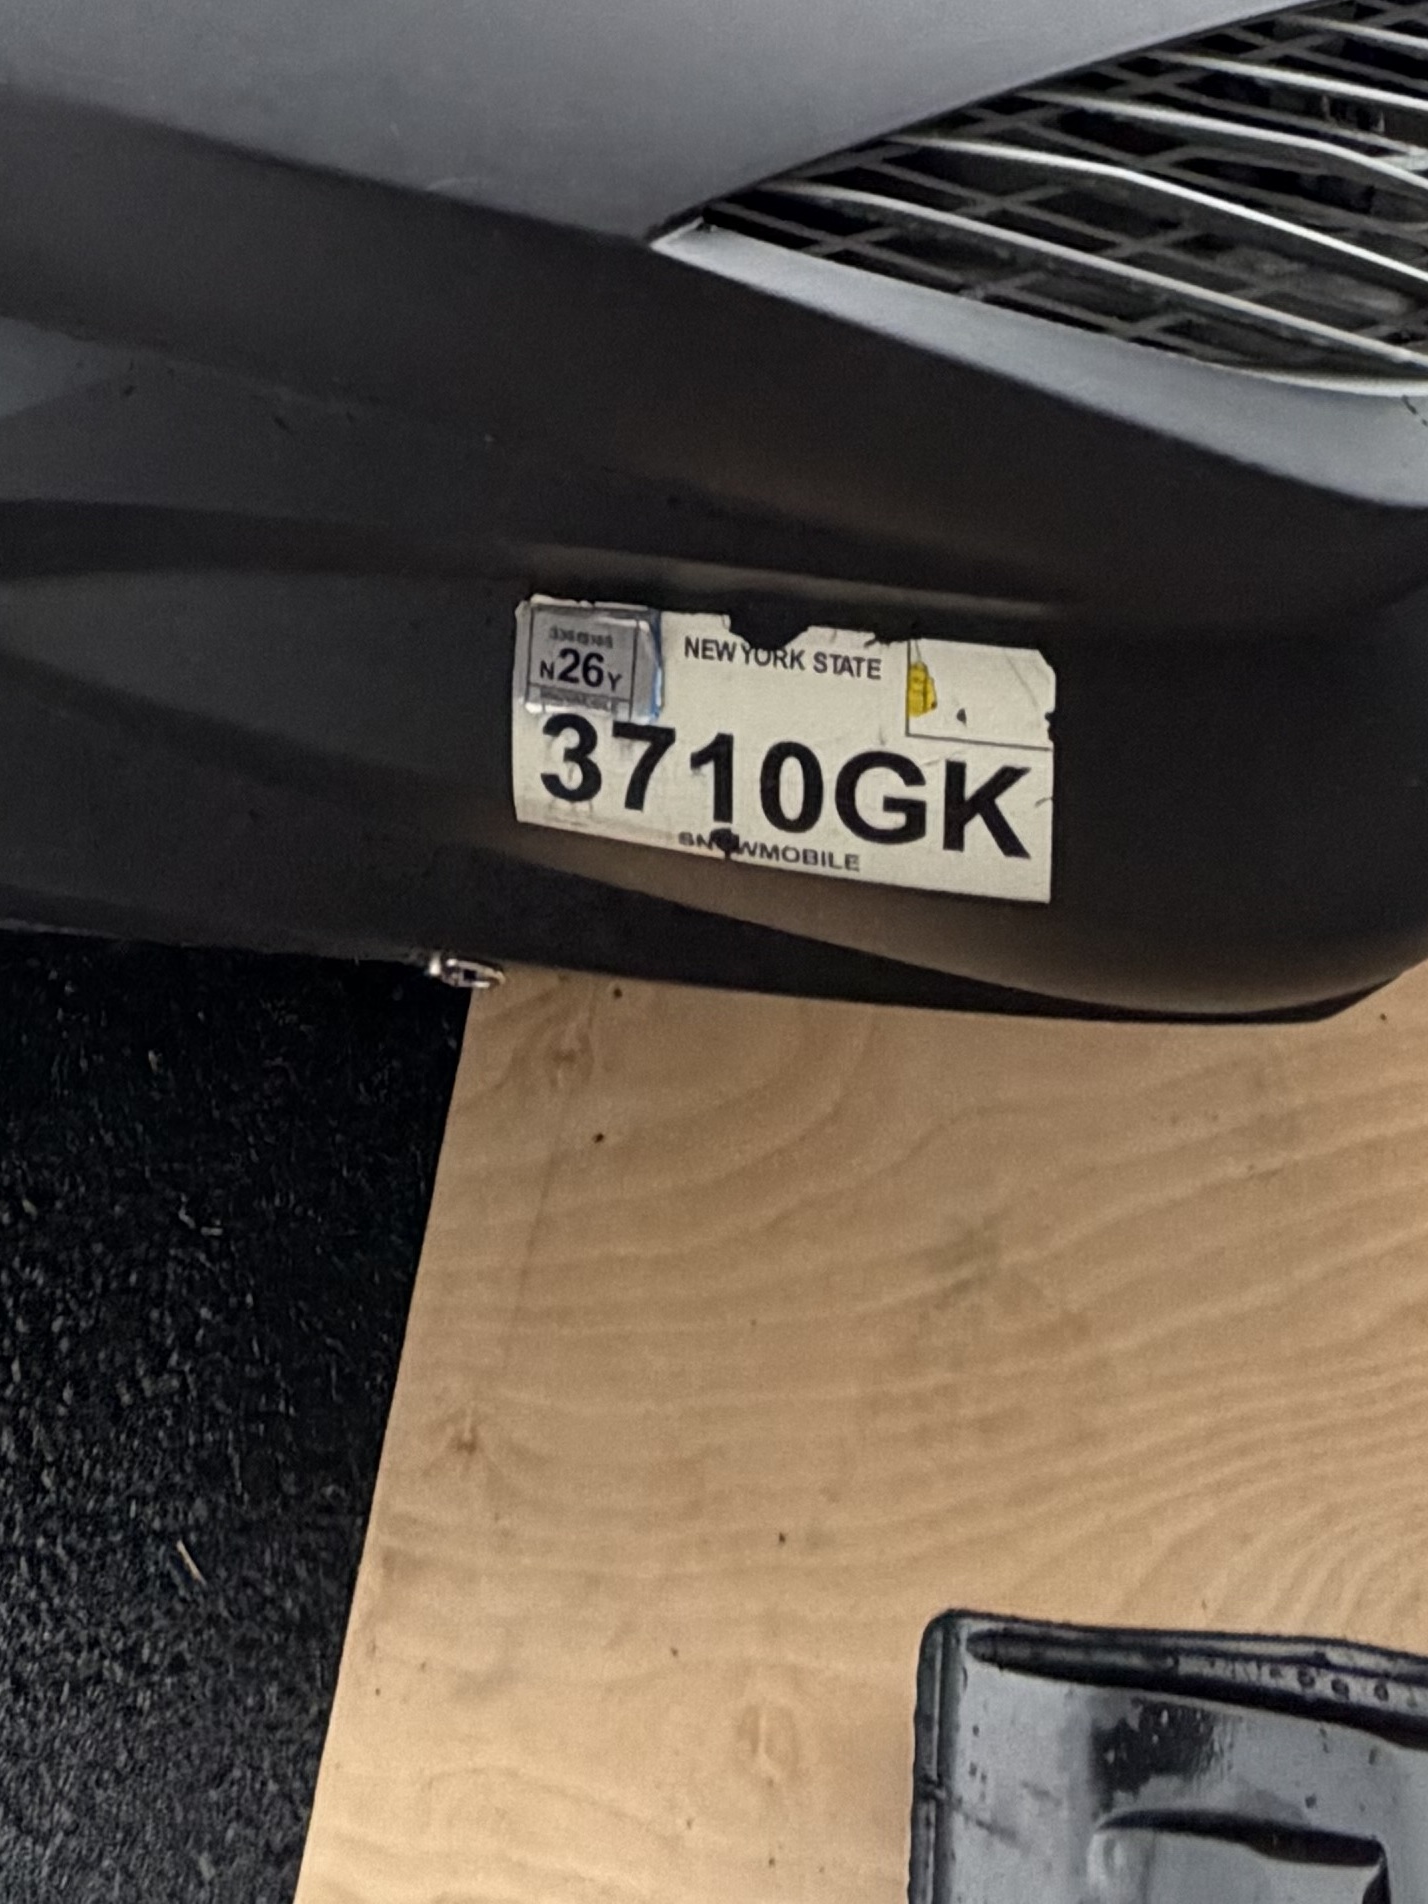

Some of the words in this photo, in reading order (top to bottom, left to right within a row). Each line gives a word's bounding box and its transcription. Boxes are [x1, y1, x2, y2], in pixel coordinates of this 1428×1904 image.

[557, 647, 605, 688] 26
[684, 635, 737, 663] NEW
[738, 642, 805, 671] YORK
[813, 651, 882, 681] STATE
[539, 712, 1032, 860] 3710GK
[677, 830, 861, 873] SNWMOBILE
